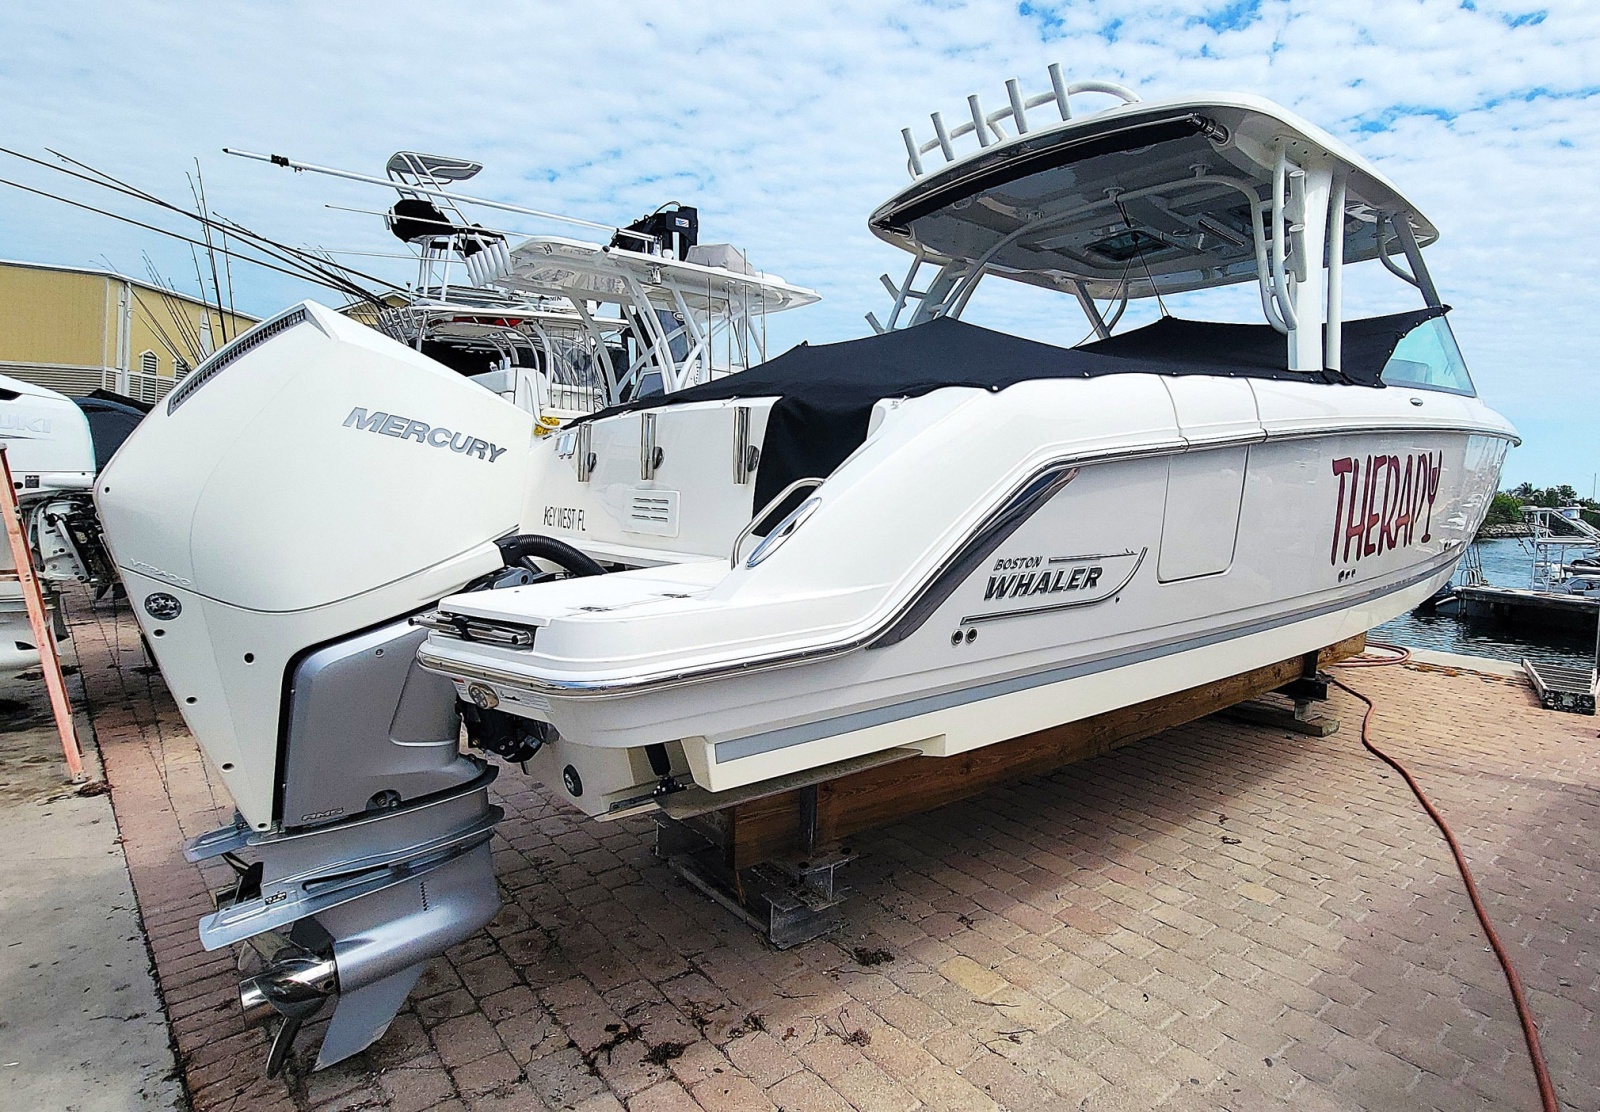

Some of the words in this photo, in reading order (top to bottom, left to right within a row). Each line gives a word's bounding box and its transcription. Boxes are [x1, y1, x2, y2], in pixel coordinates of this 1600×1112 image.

[342, 406, 508, 463] MERCURY
[543, 505, 557, 527] KEY
[557, 507, 577, 530] WEST
[577, 509, 586, 532] FL
[1331, 450, 1443, 567] THERAPY
[993, 555, 1043, 572] BOSTON
[984, 566, 1104, 601] WHALER
